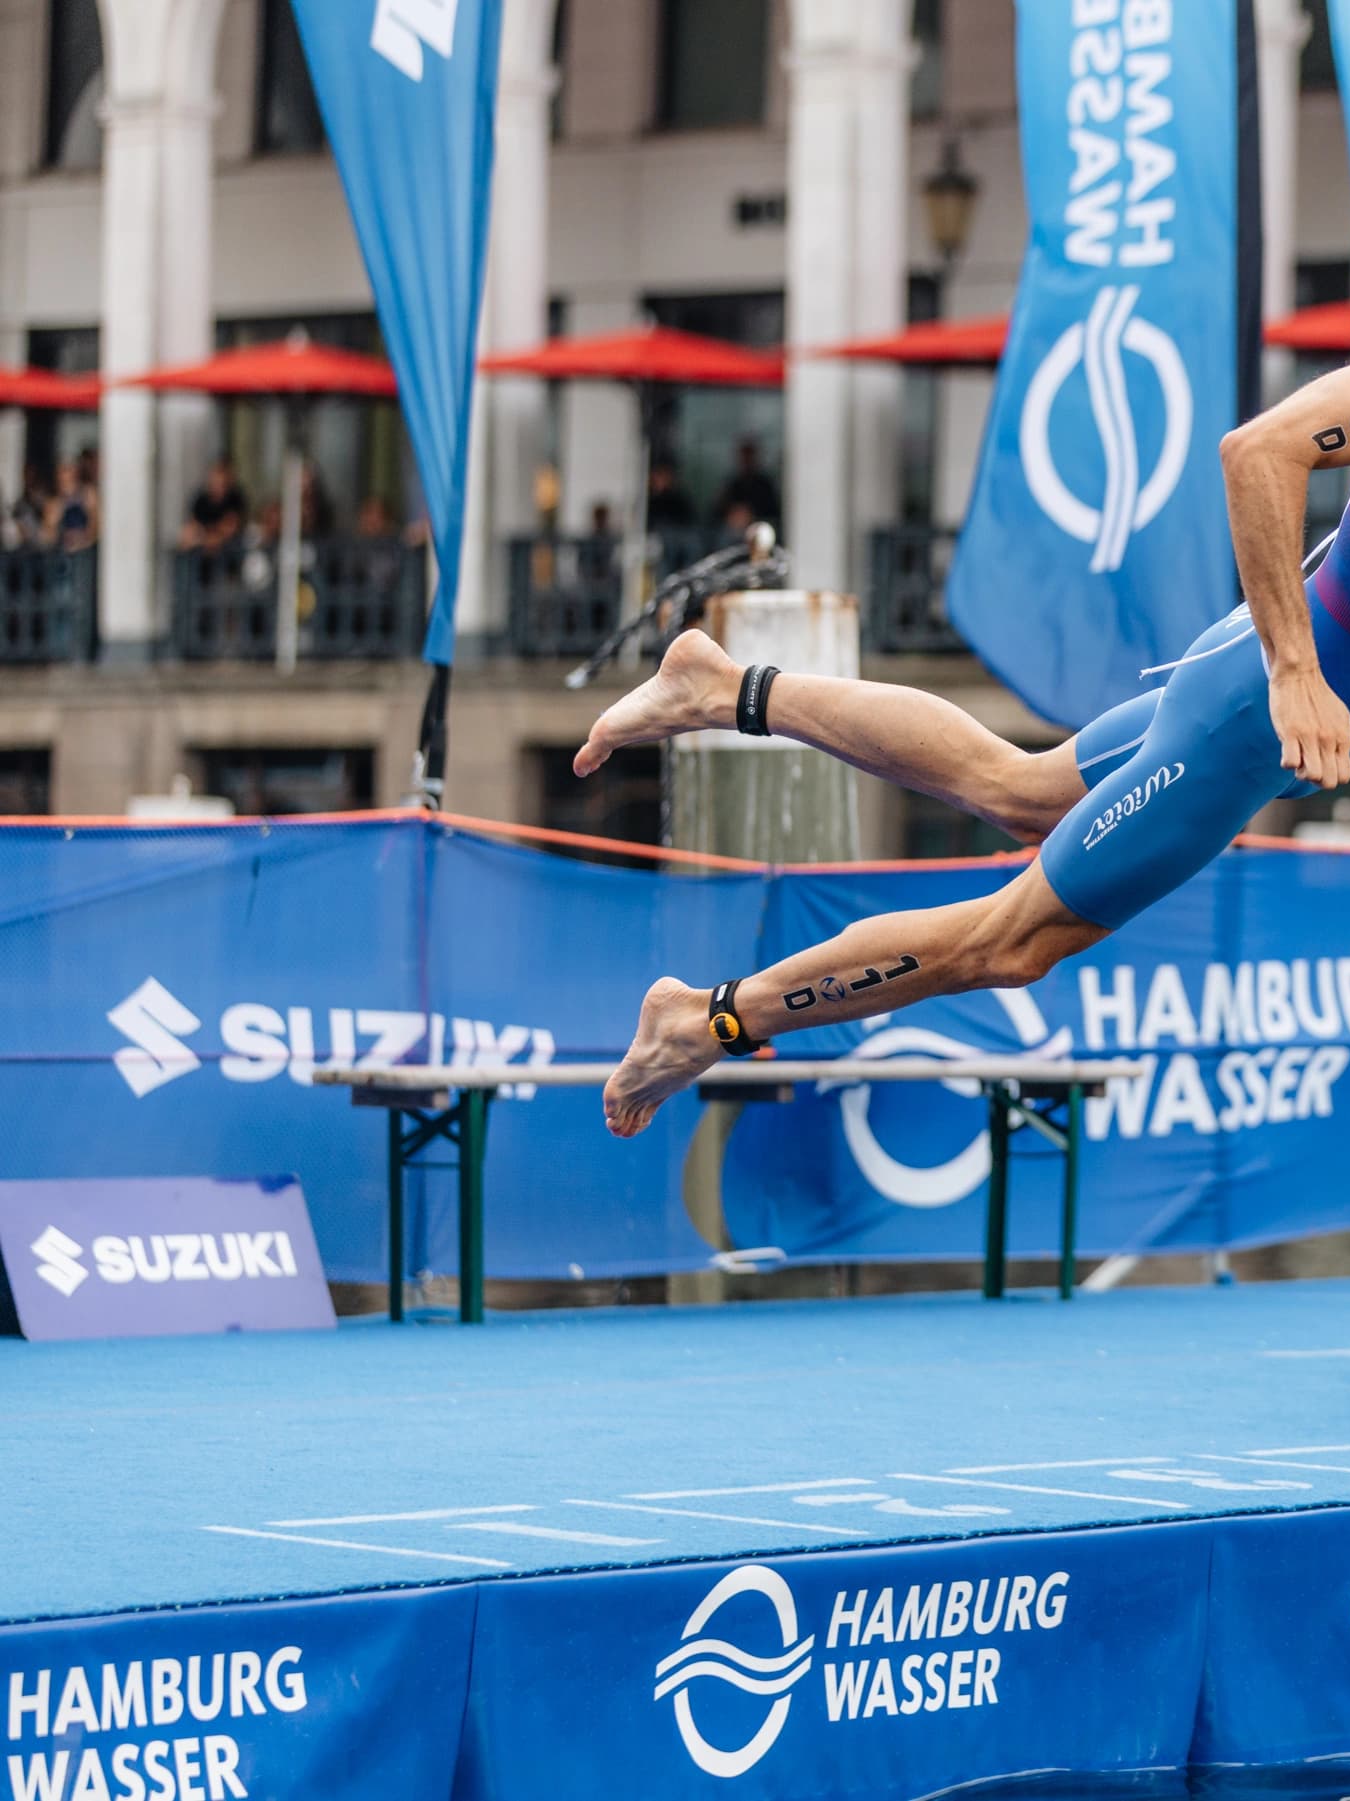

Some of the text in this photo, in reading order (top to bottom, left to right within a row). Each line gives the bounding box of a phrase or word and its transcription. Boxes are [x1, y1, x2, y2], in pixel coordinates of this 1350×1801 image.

[1083, 762, 1185, 845] Wilier
[1083, 1046, 1350, 1142] WASSER
[93, 1231, 298, 1284] SUZUKI
[825, 1571, 1070, 1649] HAMBURG
[6, 1645, 308, 1740] HAMBURG
[823, 1648, 1001, 1722] WASSER
[8, 1735, 248, 1801] WASSER
